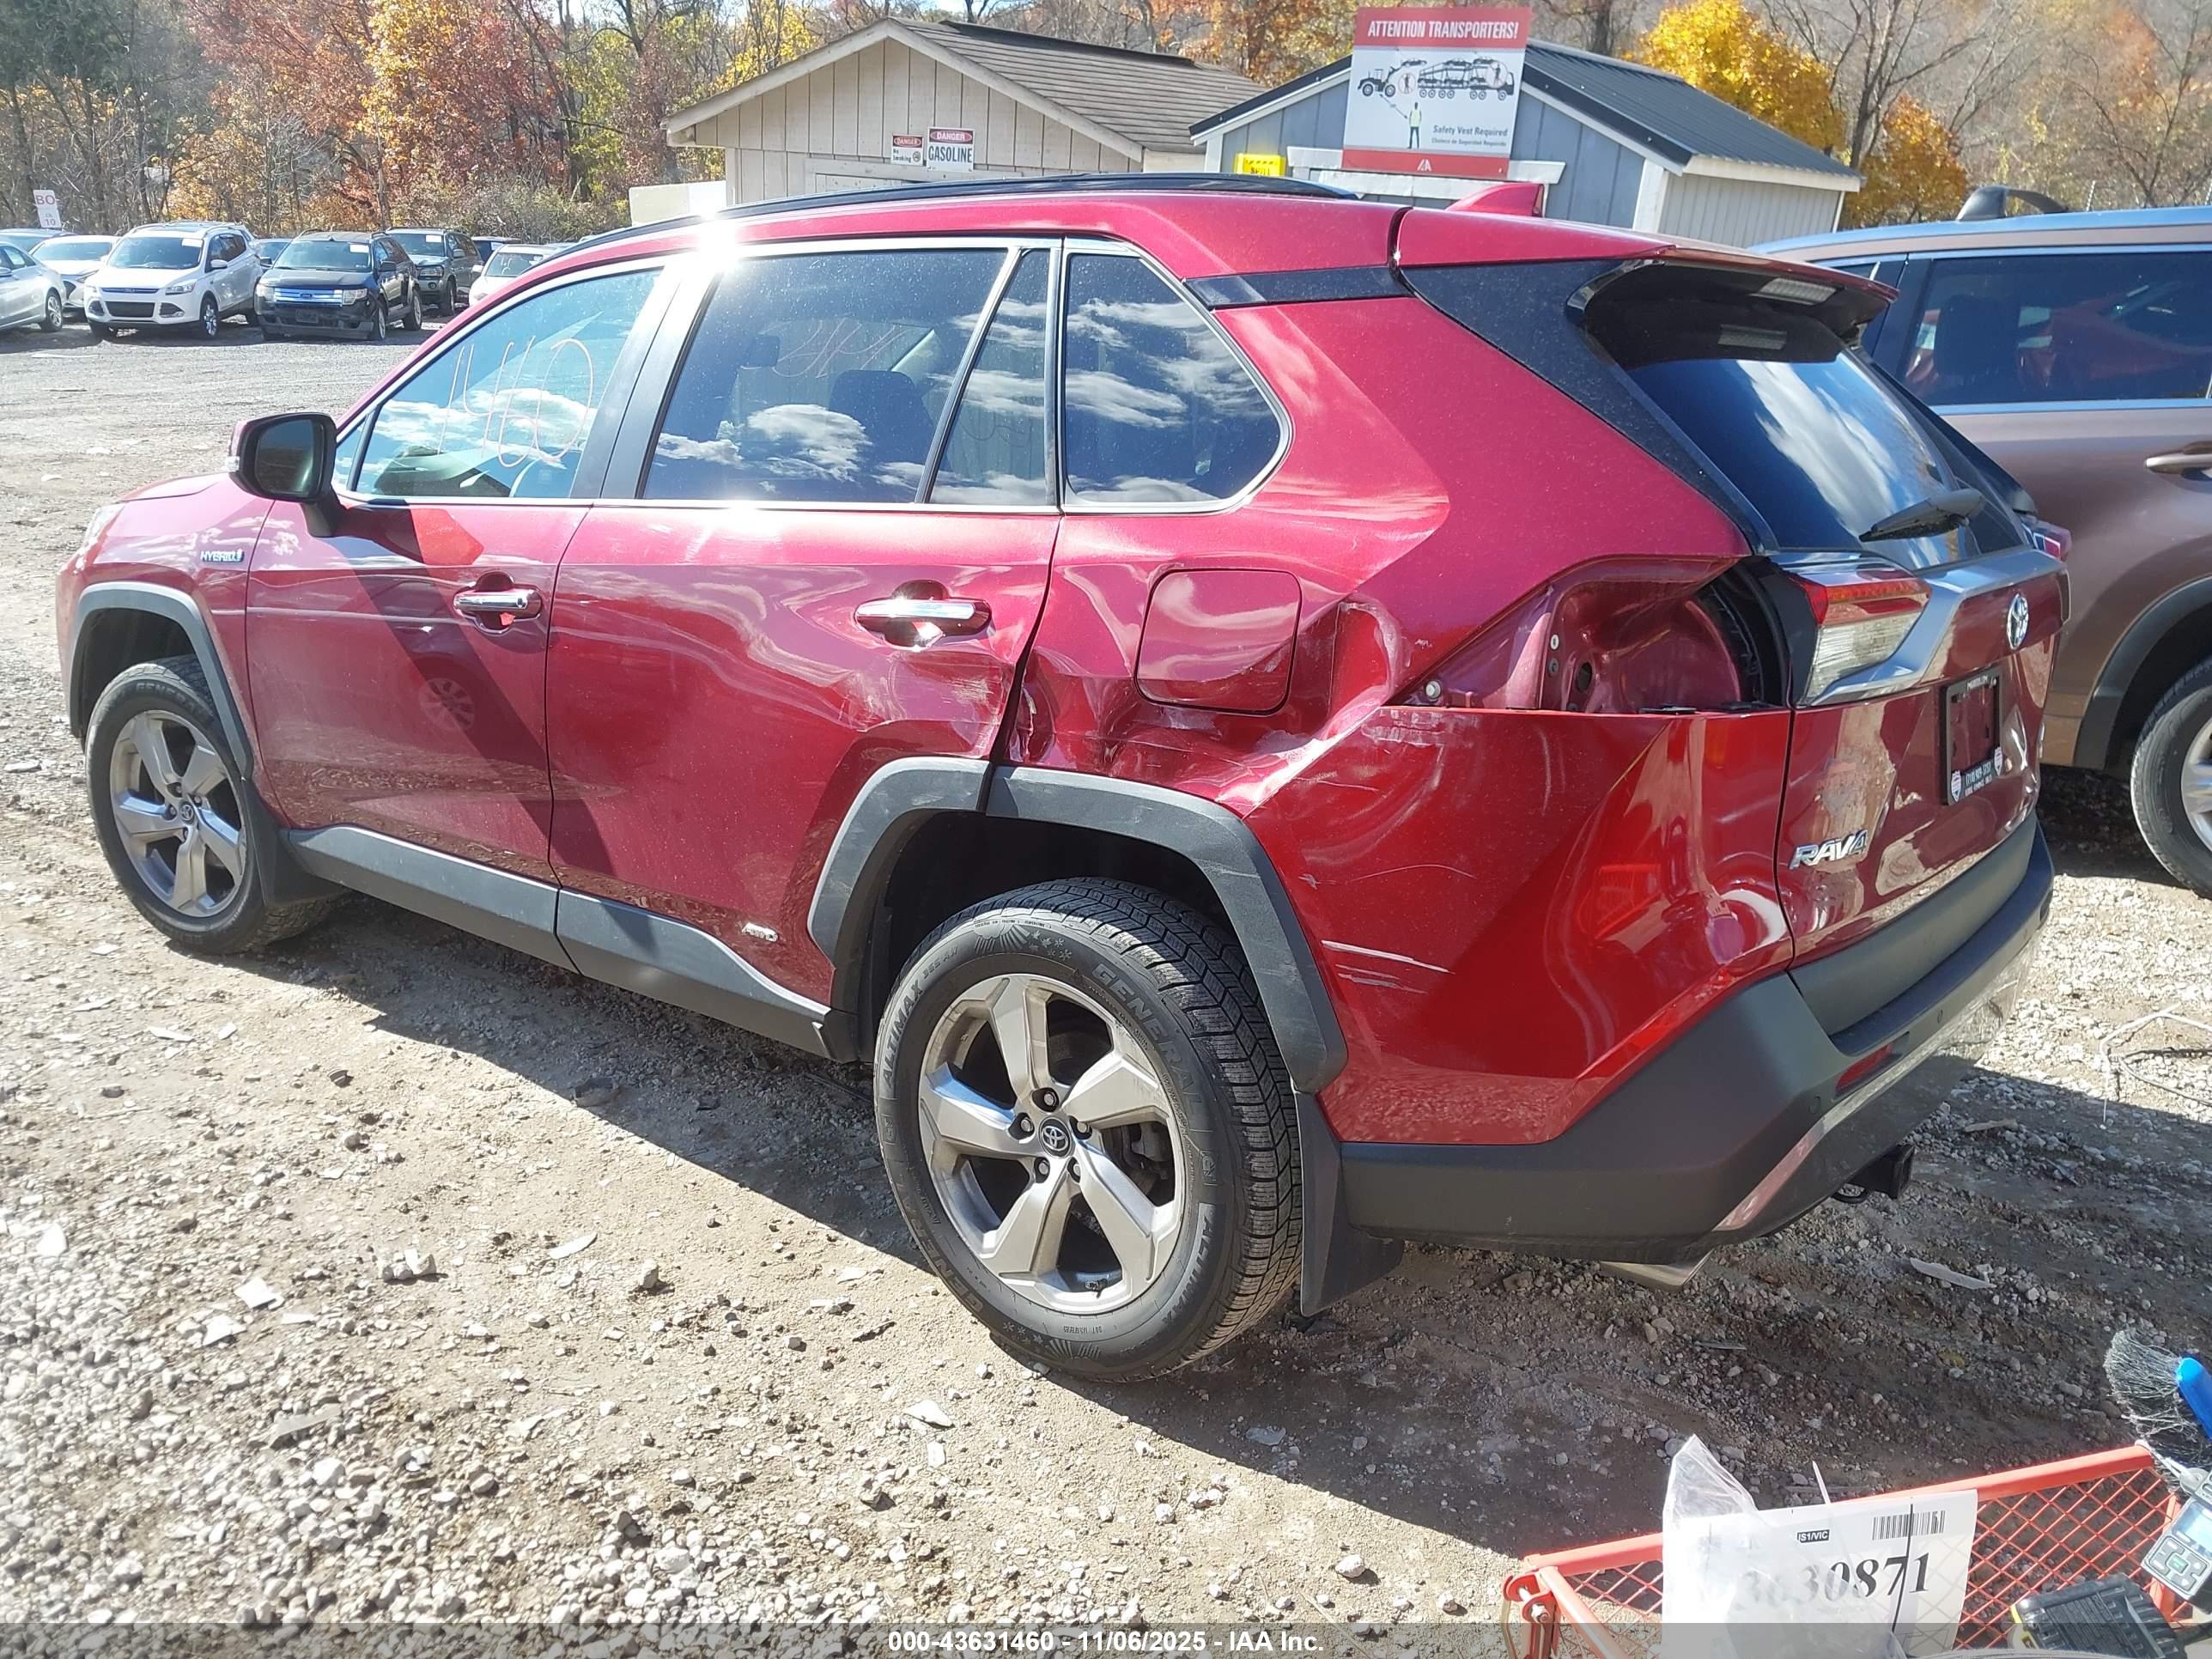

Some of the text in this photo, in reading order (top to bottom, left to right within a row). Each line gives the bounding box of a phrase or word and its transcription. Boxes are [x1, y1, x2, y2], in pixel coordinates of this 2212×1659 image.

[1368, 21, 1519, 40] ATTENTION TRANSPORTERS!
[937, 132, 965, 142] DANGER
[1433, 125, 1508, 137] Safety Vest Required
[896, 137, 918, 145] DANGER
[928, 146, 972, 162] GASOLINE
[1789, 829, 1868, 870] RAV4
[883, 979, 924, 1088] ALTIMAX
